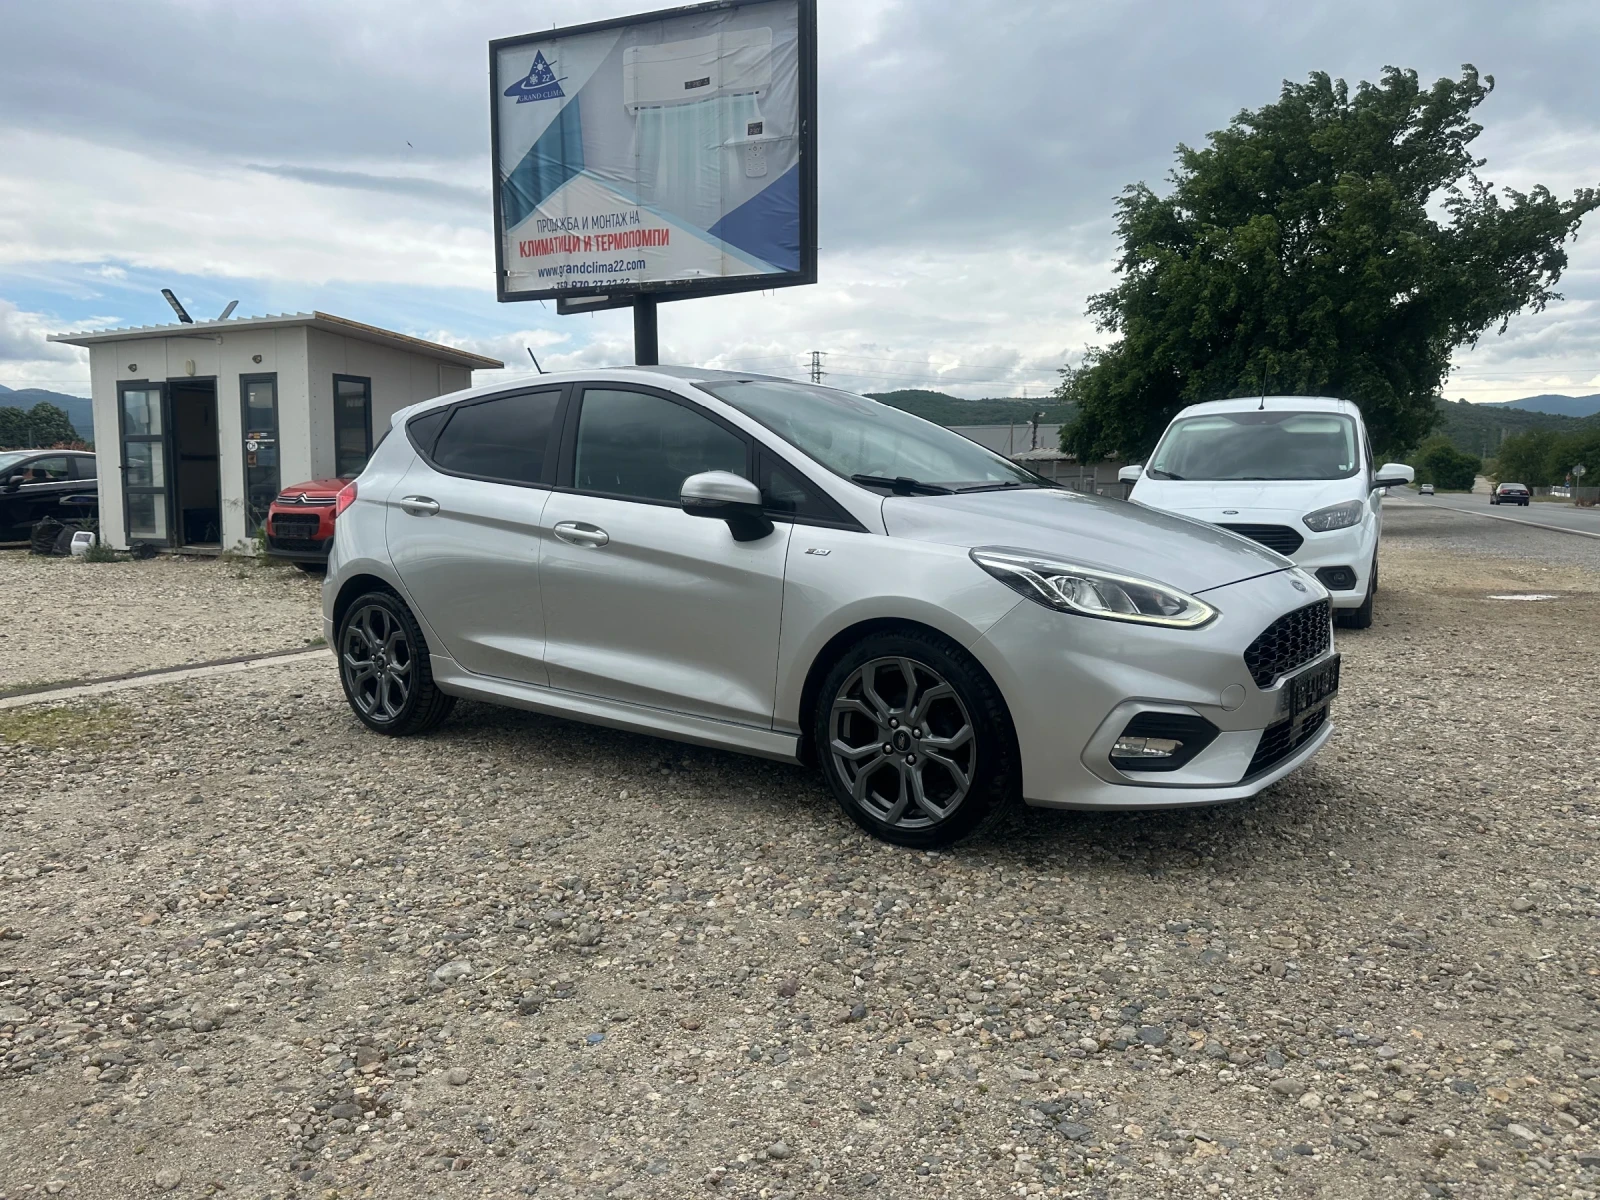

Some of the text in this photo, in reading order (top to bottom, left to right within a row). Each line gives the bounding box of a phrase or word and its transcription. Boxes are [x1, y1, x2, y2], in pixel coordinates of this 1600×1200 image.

[519, 89, 563, 102] GRAND CLIMA
[537, 210, 640, 233] ПРОДАЖБА И МОНТАЖ НА
[519, 229, 670, 258] КЛИМАТИЦИ И ТЕРМОПОМПИ
[538, 259, 646, 278] www.grandclima22.com
